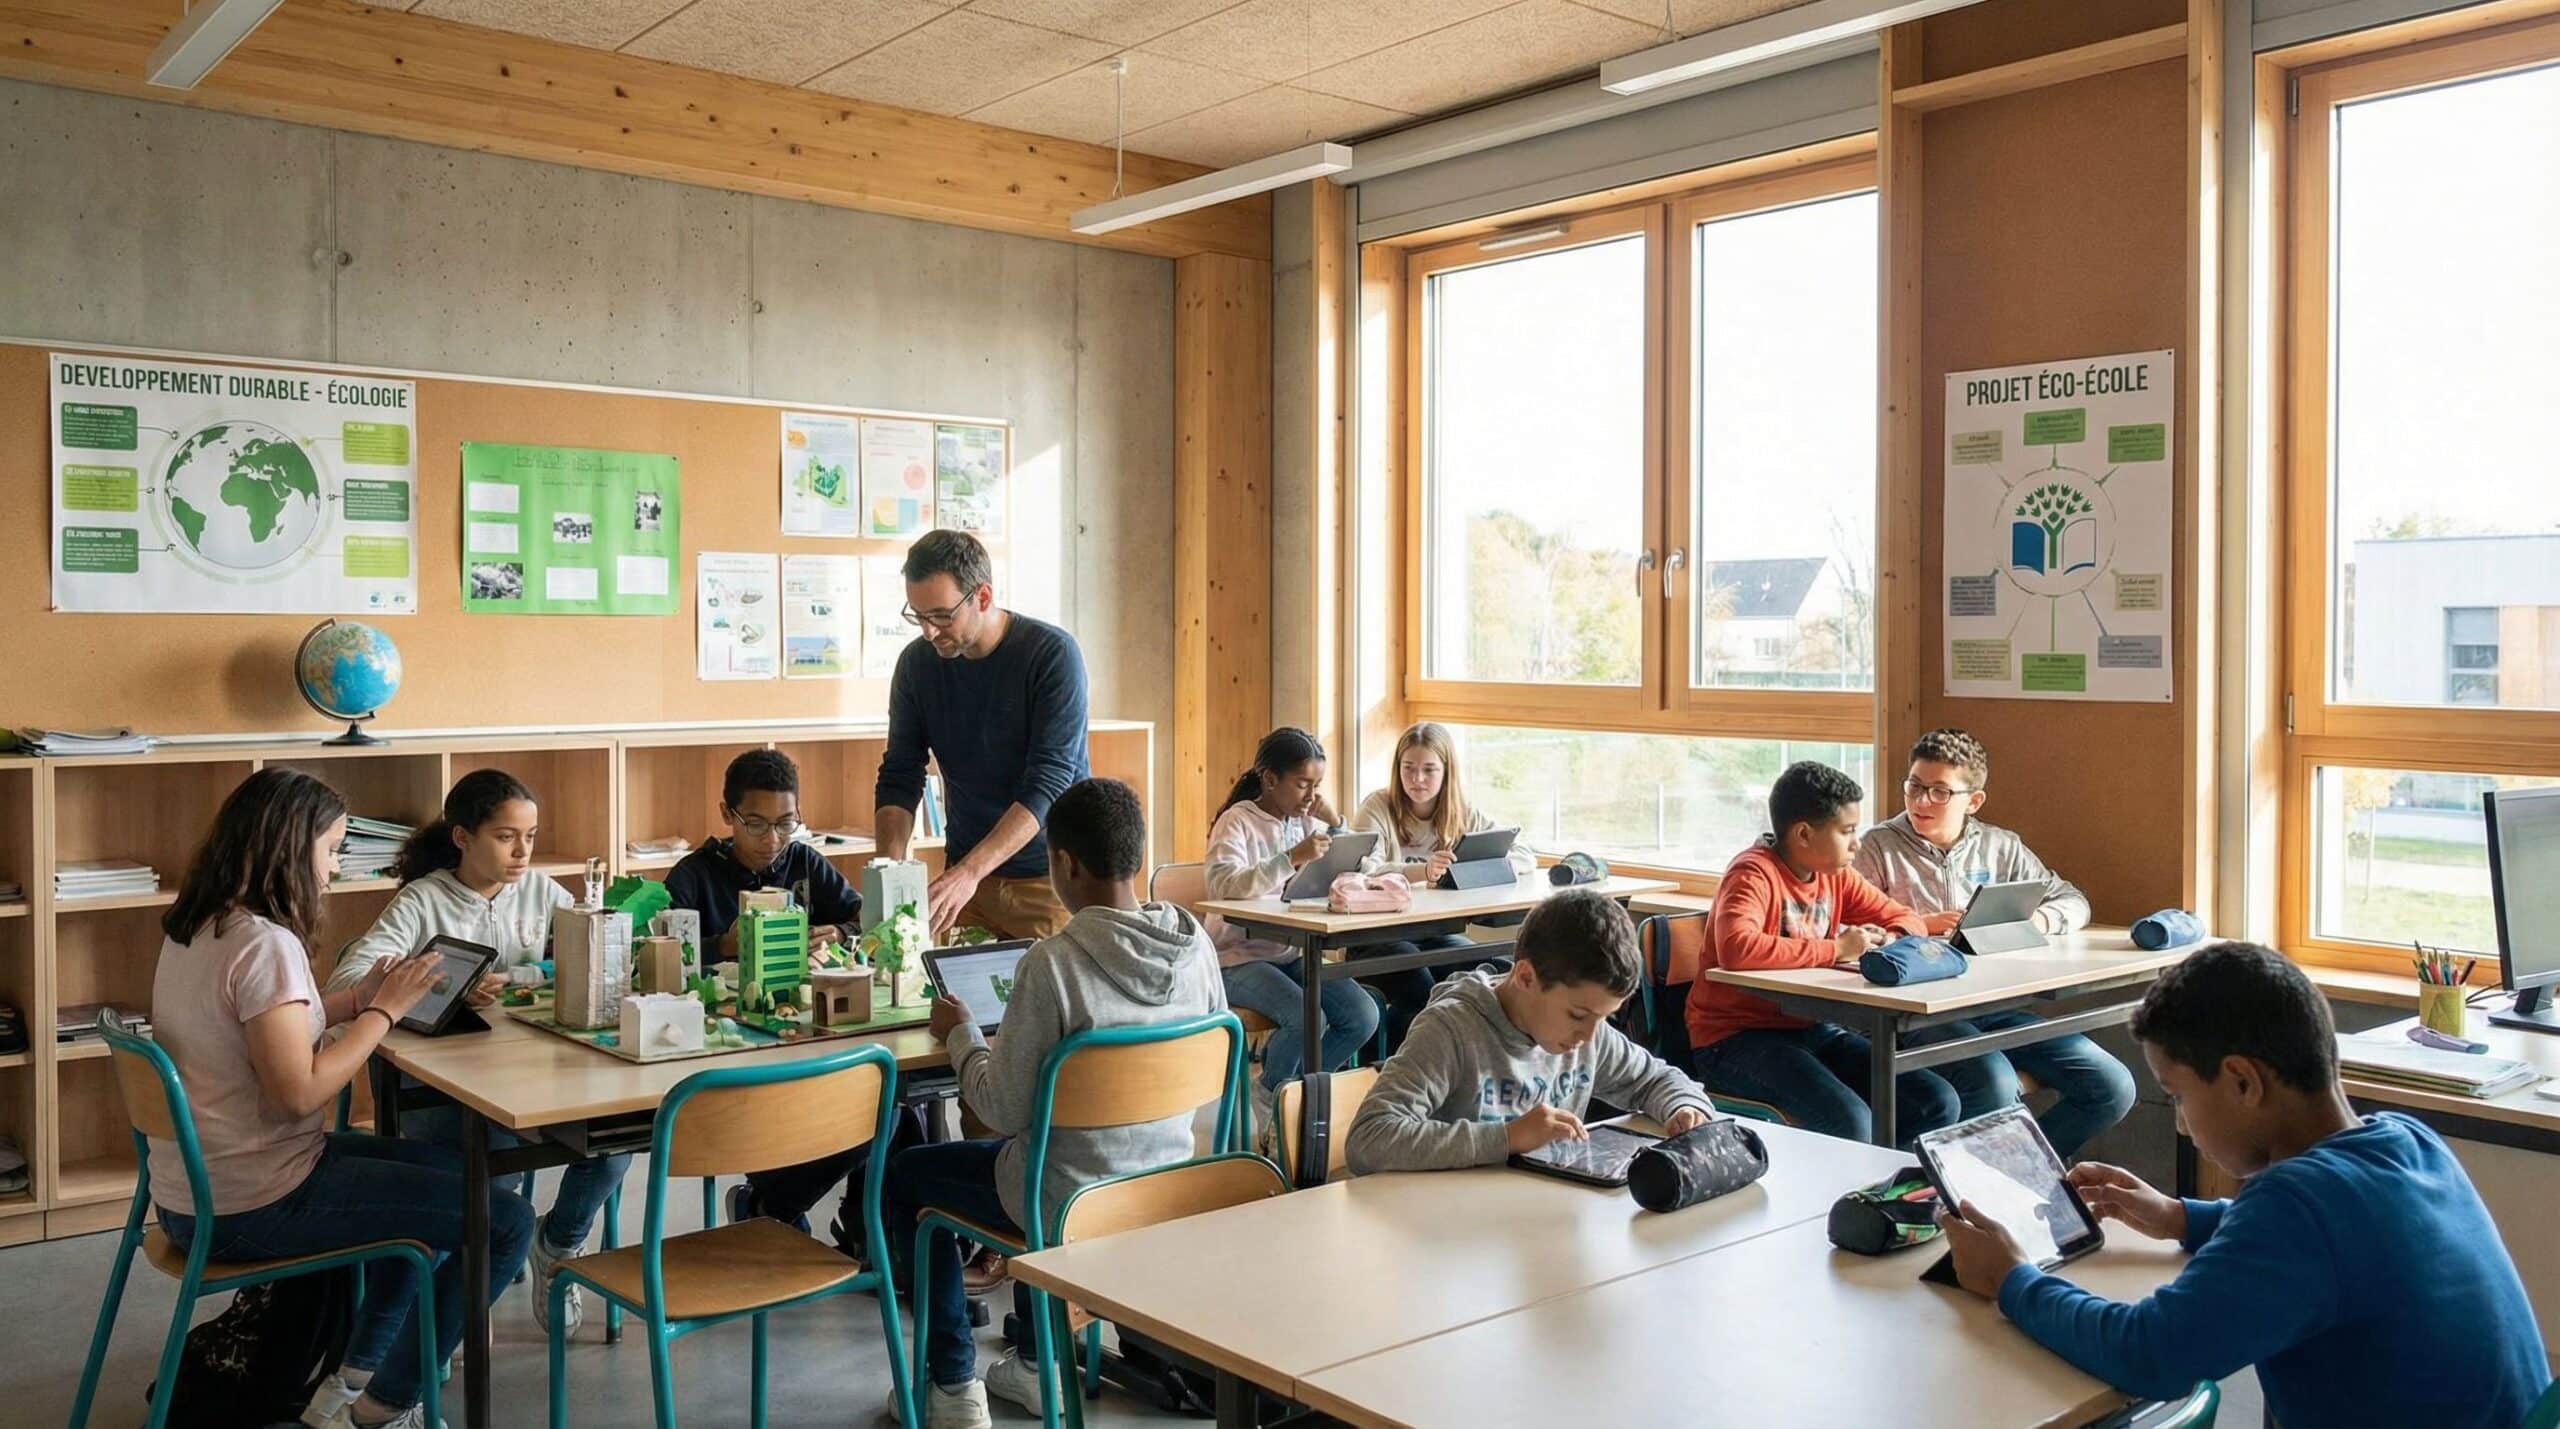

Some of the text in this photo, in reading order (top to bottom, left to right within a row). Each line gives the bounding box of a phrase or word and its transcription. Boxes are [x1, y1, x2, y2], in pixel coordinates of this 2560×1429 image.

[61, 363, 223, 395] DEVELOPPEMENT
[229, 376, 310, 401] DURABLE
[327, 379, 408, 409] ÉCOLOGIE
[1966, 364, 2149, 406] PROJET ÉCO-ÉCOLE
